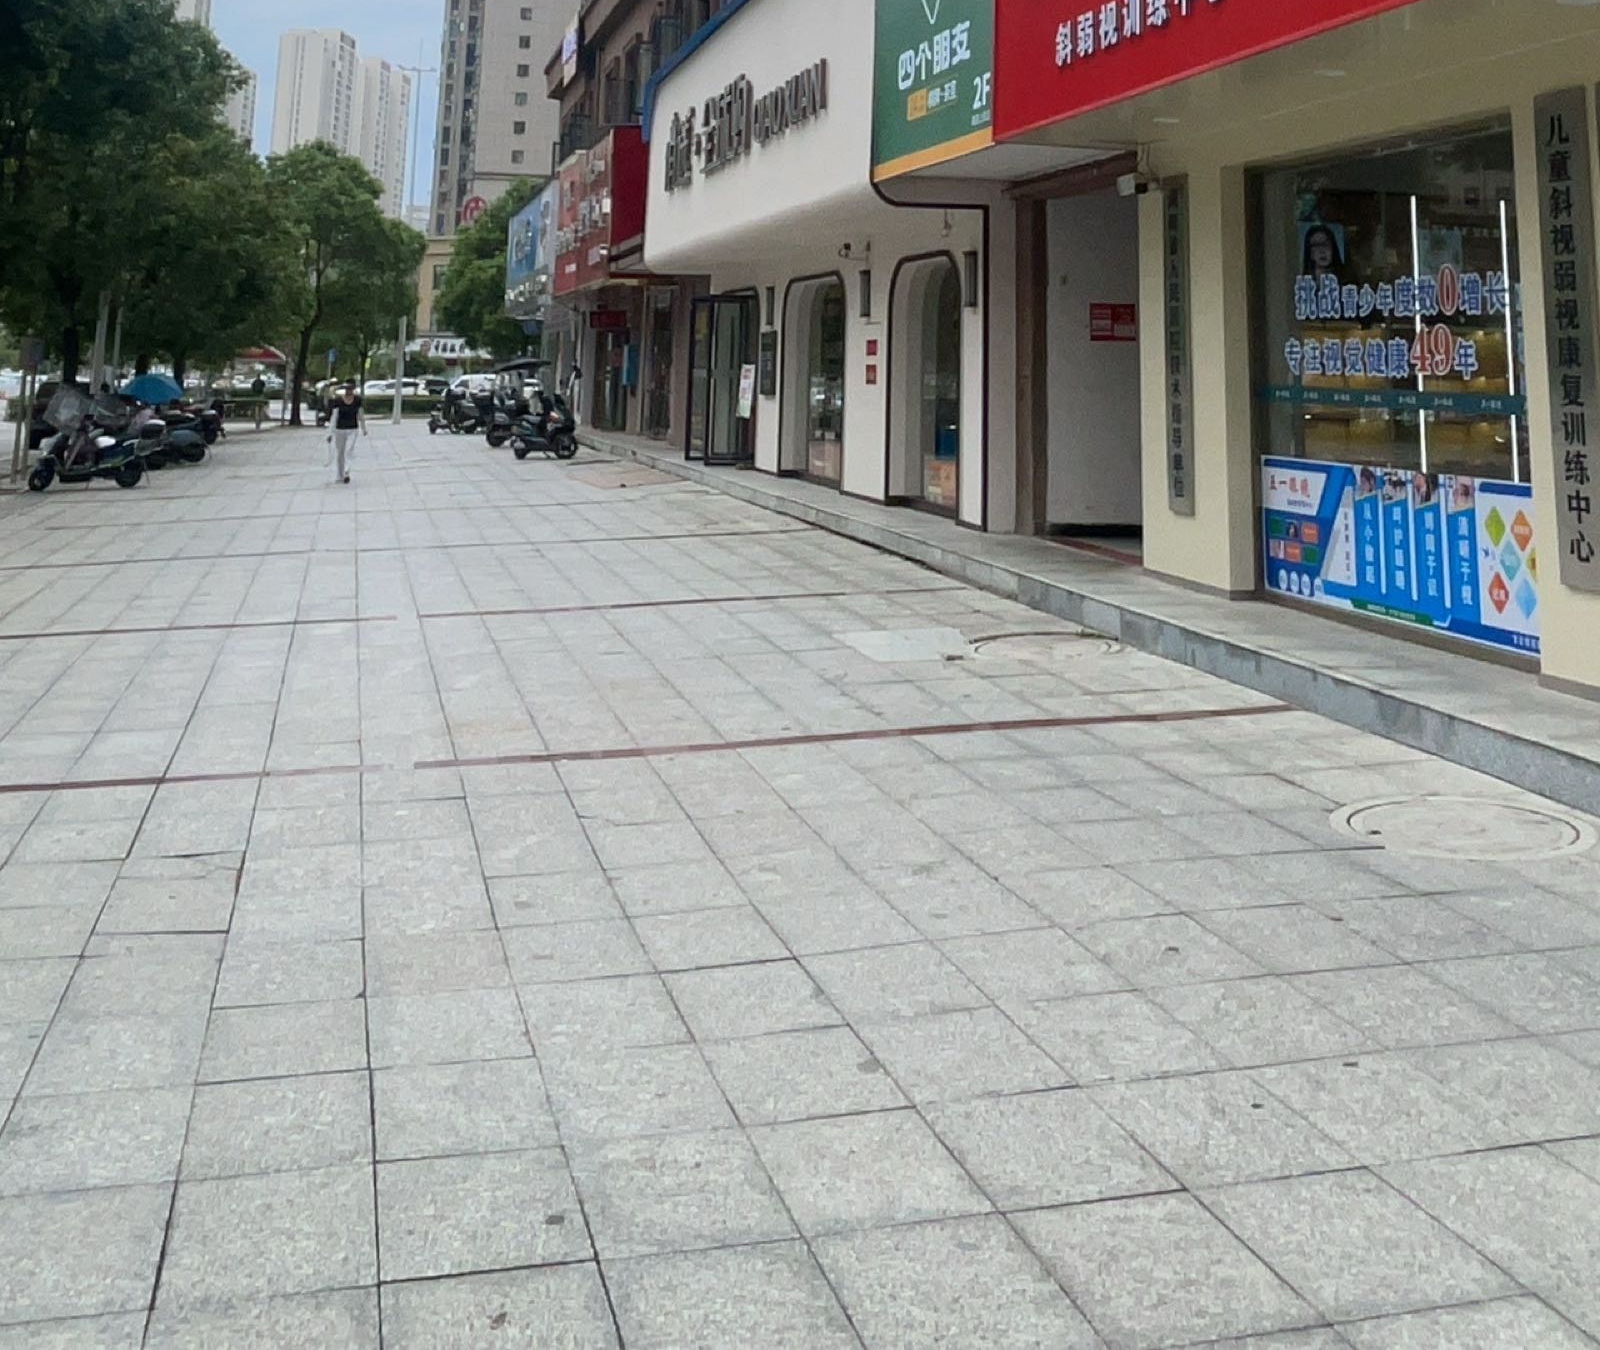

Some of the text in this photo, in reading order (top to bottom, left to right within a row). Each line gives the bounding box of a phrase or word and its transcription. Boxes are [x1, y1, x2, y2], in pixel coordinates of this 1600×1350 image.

[898, 20, 971, 91] 四个朋友
[973, 71, 992, 110] 2F
[1294, 263, 1508, 320] 挑战青少年度数0增长
[1284, 323, 1480, 381] 专注视觉健康49年
[1544, 114, 1596, 563] 儿童斜视弱视康复训练中心
